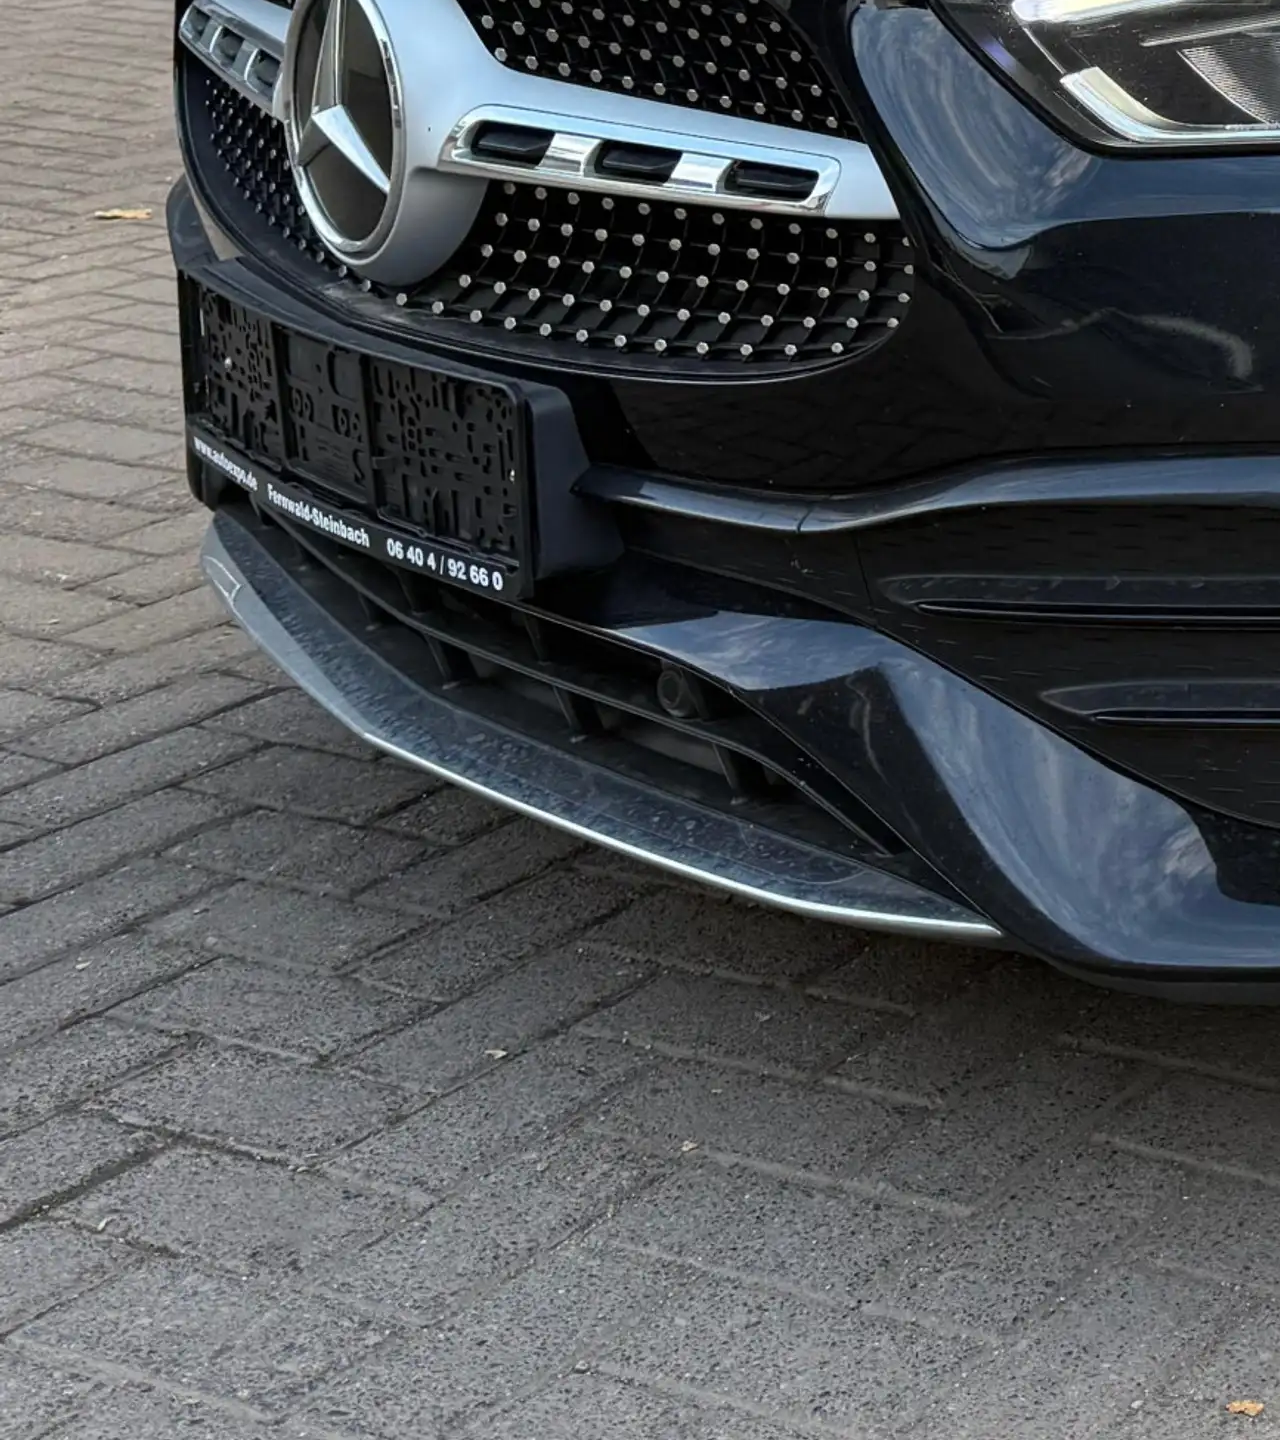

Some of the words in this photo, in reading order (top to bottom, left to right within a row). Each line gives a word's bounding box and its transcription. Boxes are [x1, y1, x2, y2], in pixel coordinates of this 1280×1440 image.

[267, 483, 371, 548] Fernwald-Steinbach
[386, 537, 405, 560] 06
[406, 545, 424, 567] 40
[427, 552, 437, 571] 4
[447, 558, 467, 581] 92
[469, 564, 489, 587] 66
[491, 571, 504, 591] 0
